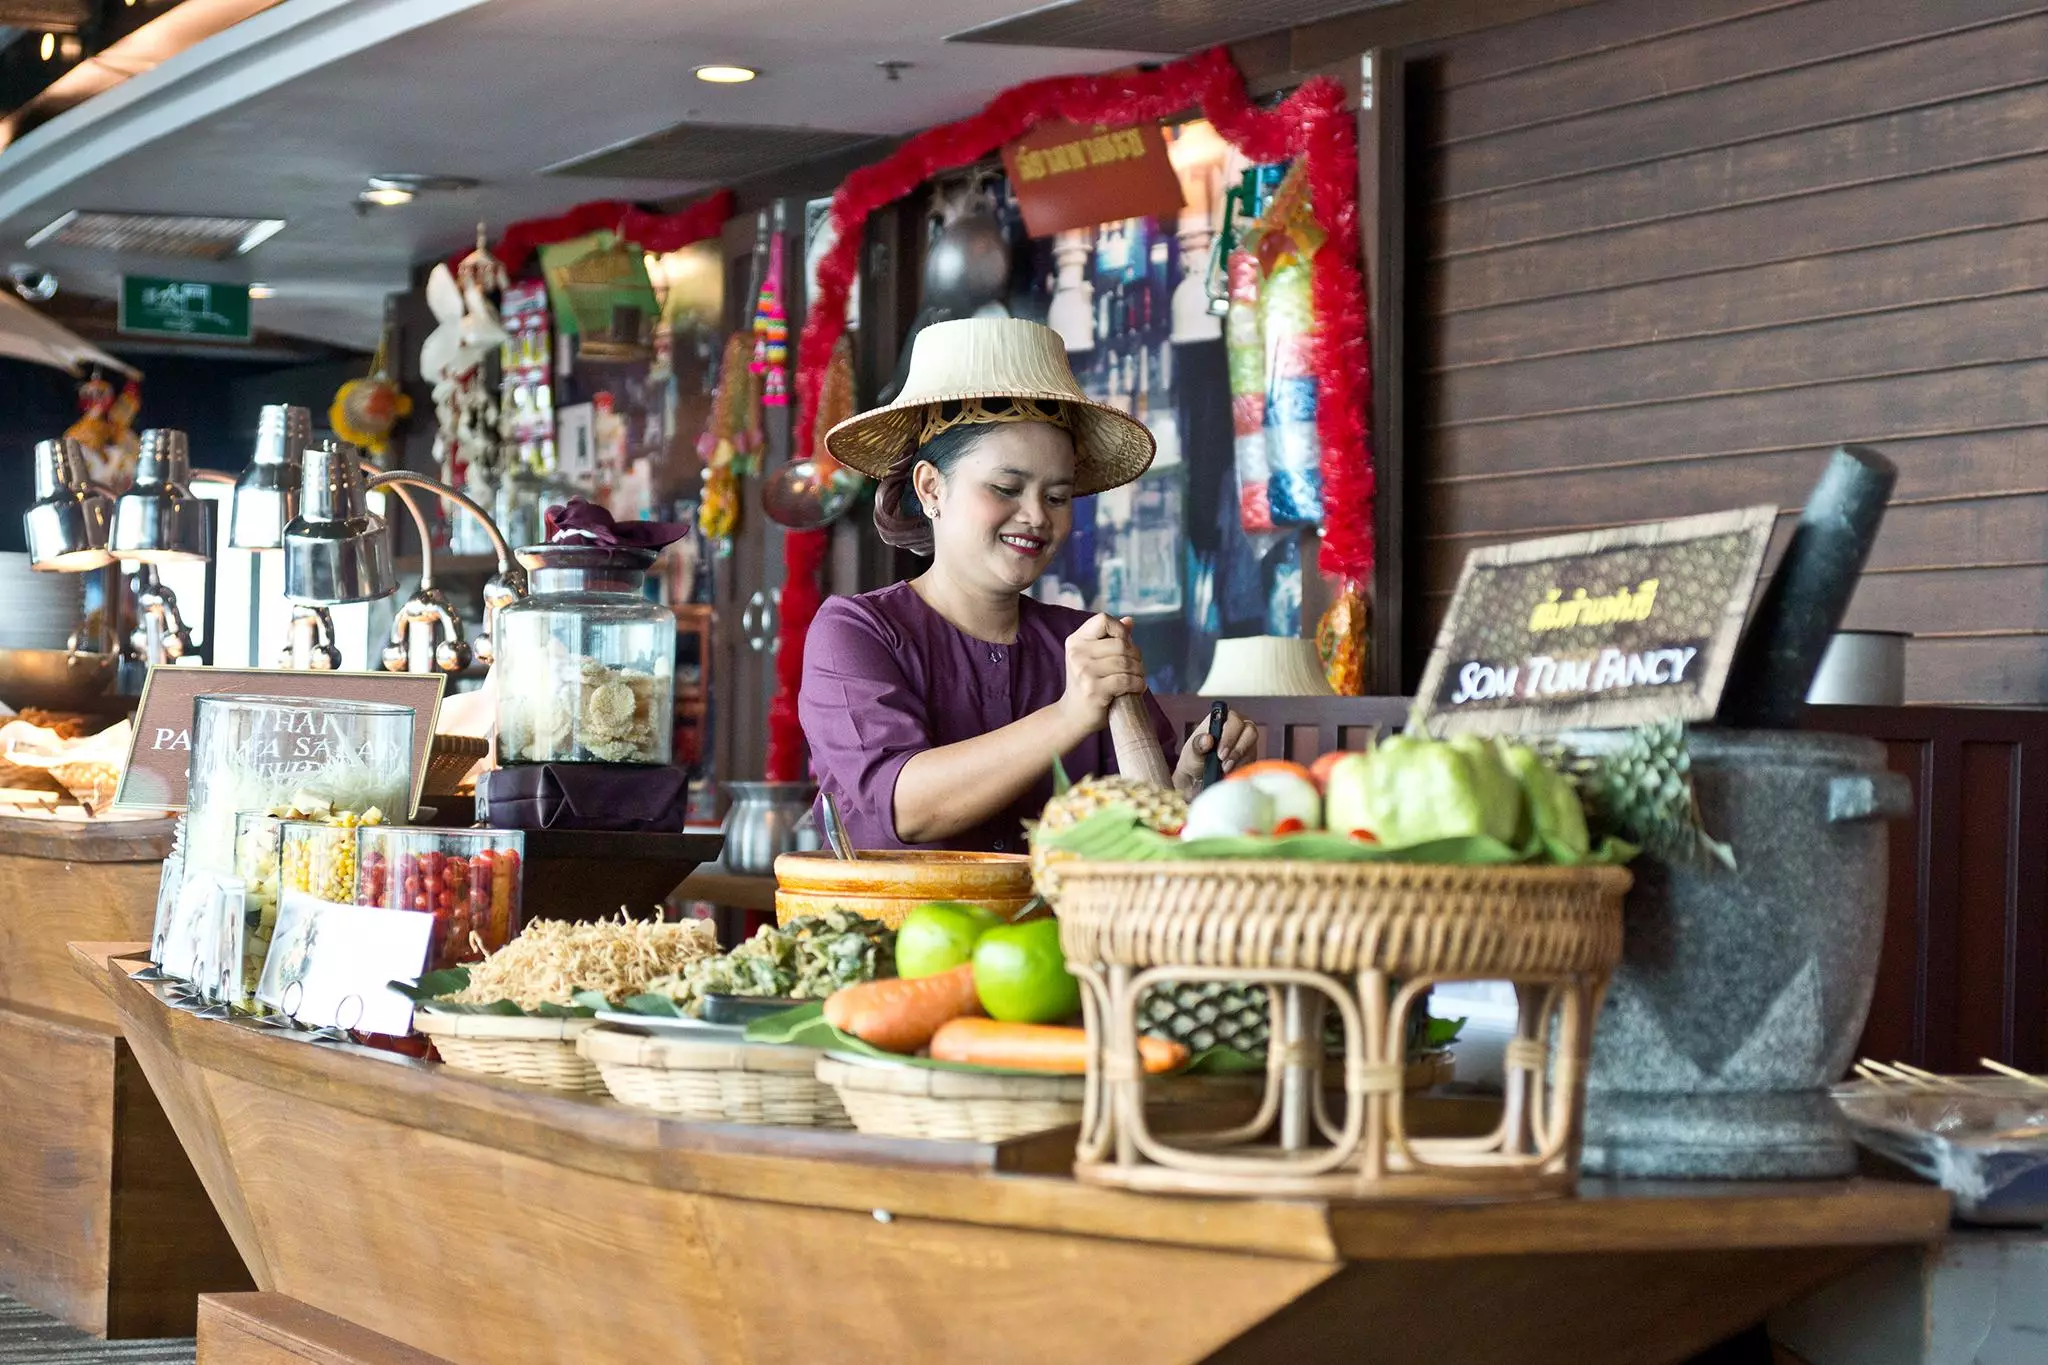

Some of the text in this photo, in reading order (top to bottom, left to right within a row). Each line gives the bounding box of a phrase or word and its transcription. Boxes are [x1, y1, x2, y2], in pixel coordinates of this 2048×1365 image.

[1451, 646, 1698, 704] SOM TUM FANCY
[292, 736, 402, 762] SAAD
